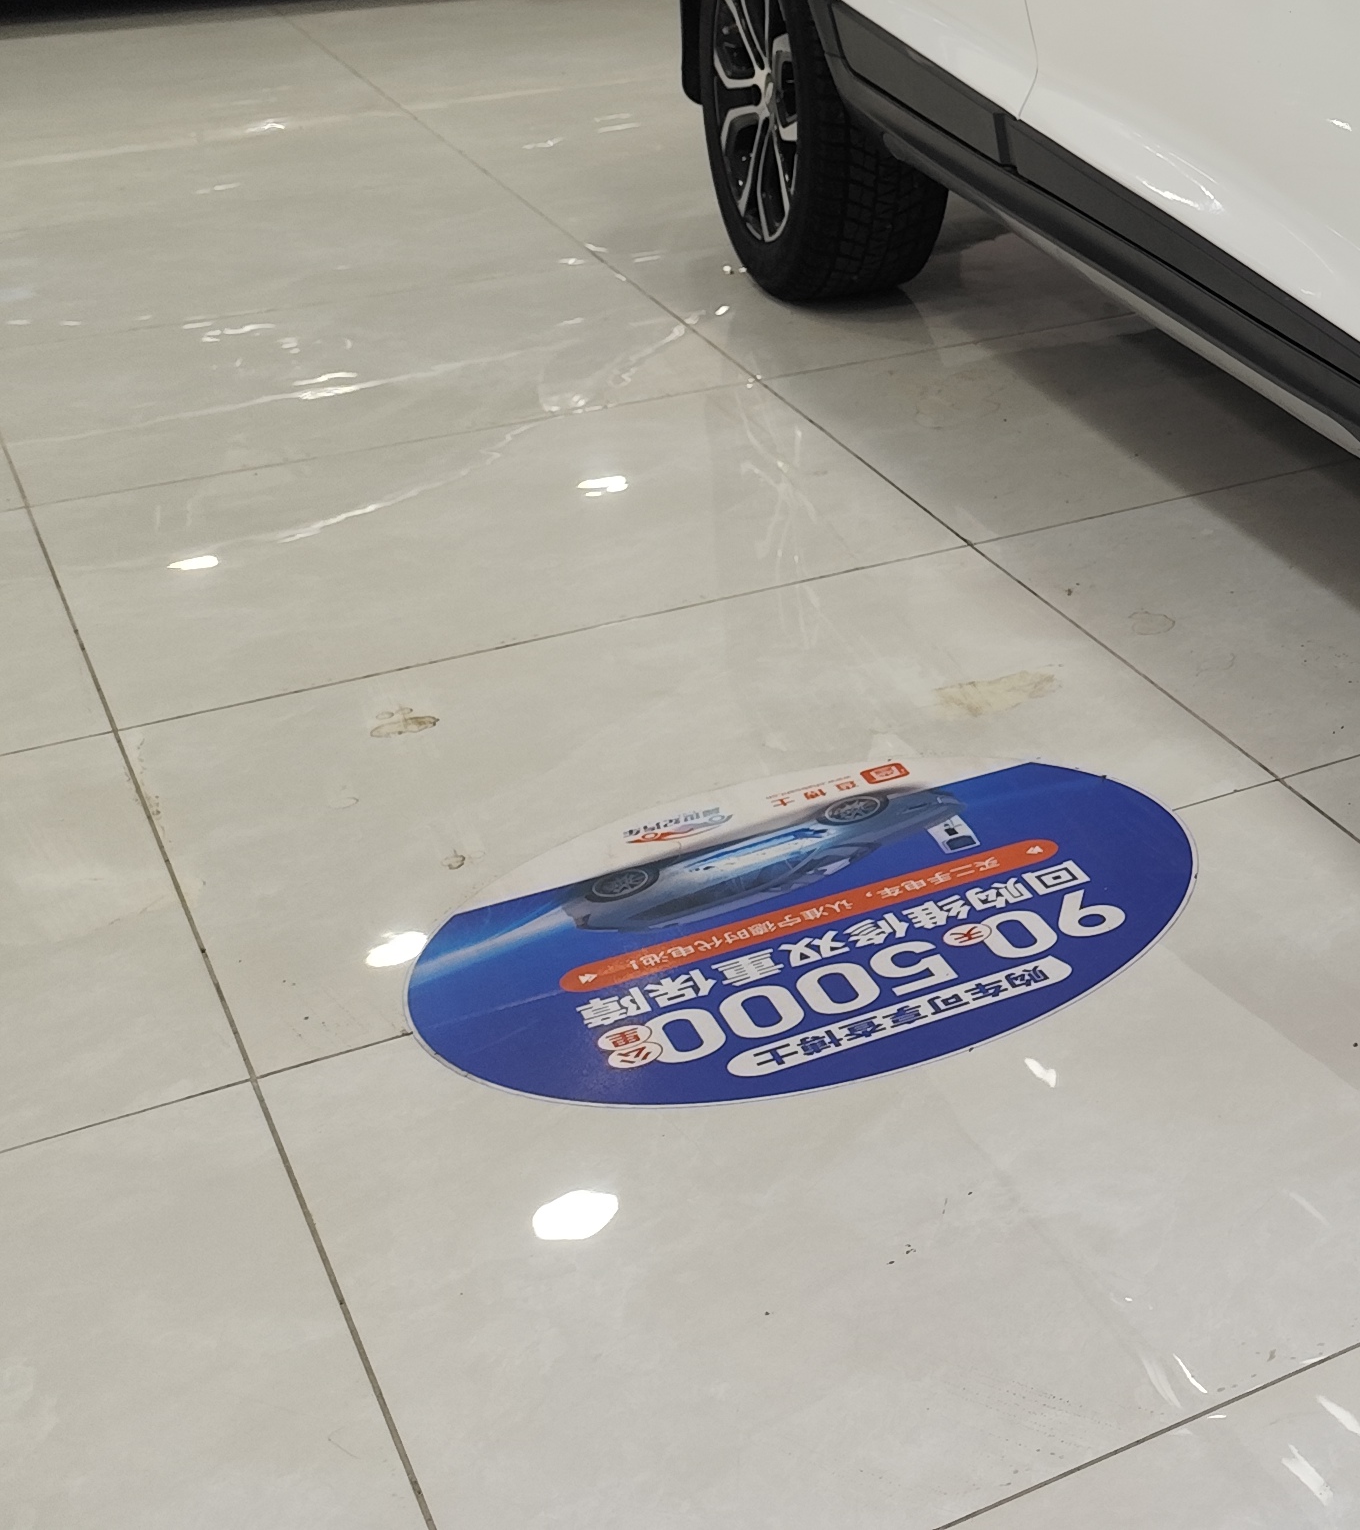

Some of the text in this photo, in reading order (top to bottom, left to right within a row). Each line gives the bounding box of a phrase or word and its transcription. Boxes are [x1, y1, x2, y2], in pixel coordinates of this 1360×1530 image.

[580, 858, 1092, 1031] 回购维修双重保障
[753, 962, 1050, 1069] 购车可享查博士
